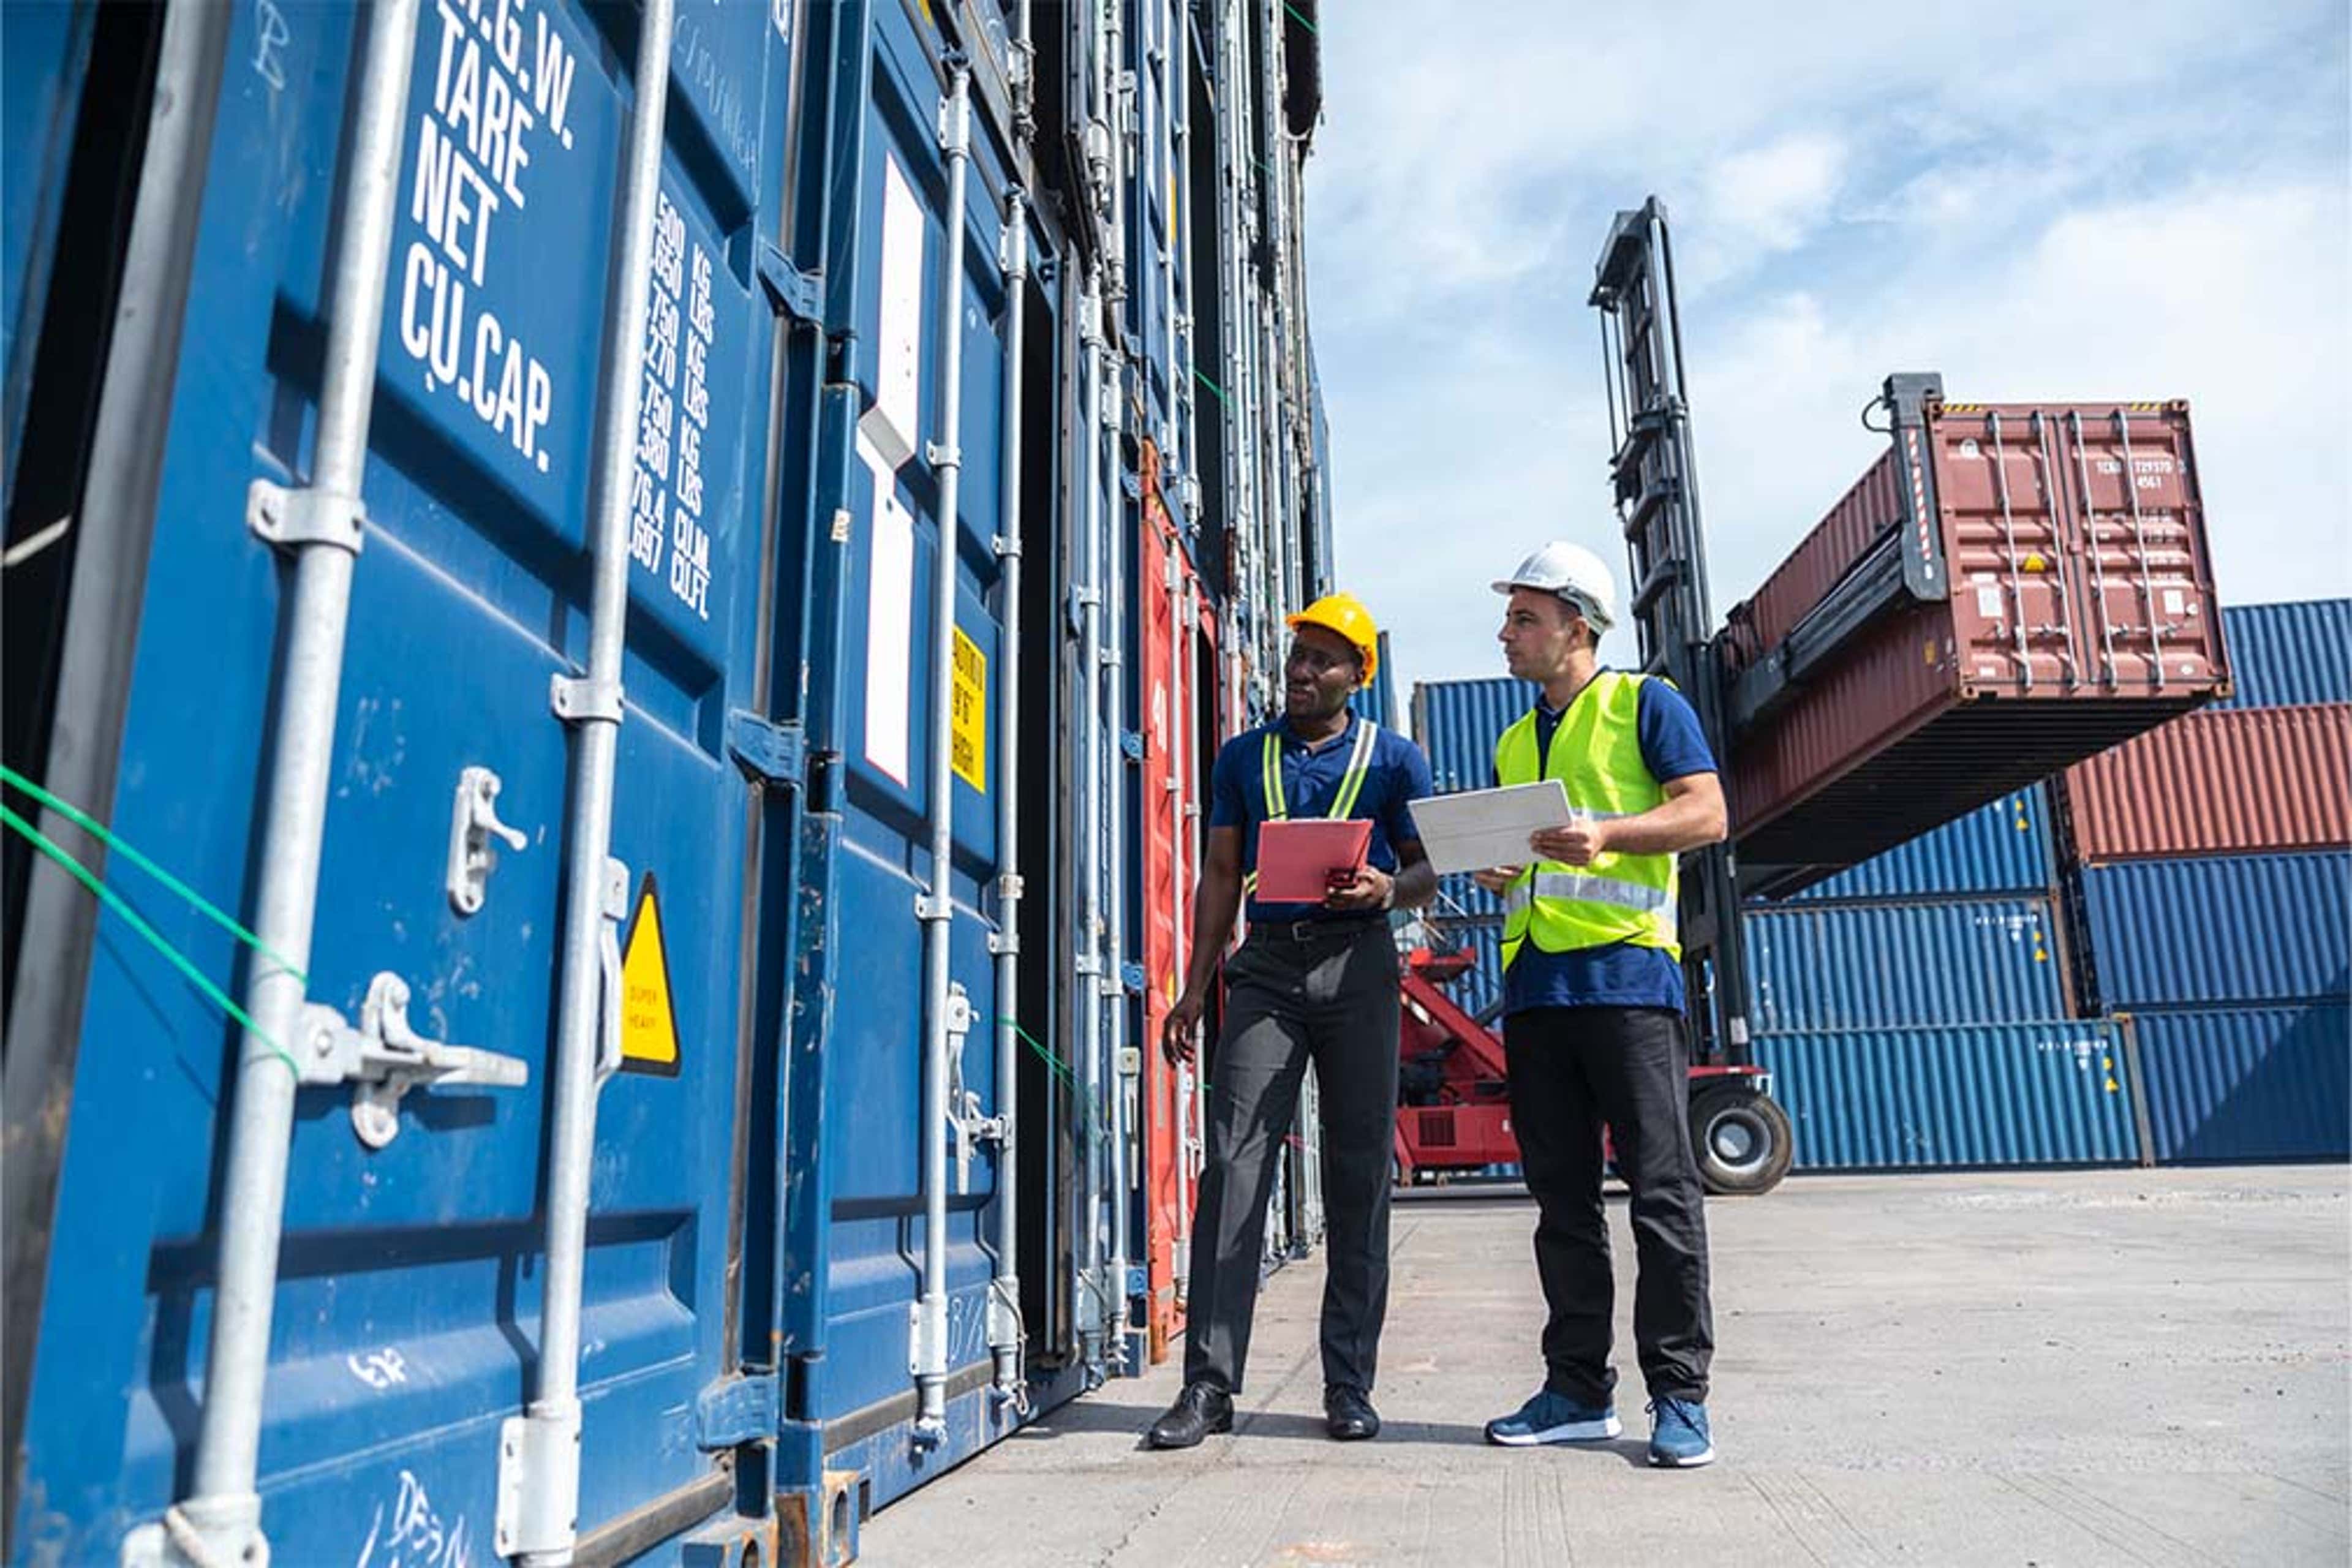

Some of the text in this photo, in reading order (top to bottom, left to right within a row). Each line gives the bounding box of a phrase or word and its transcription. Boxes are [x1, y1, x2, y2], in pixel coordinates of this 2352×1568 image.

[434, 0, 534, 209] TARE
[456, 0, 575, 150] .G.W.
[412, 113, 500, 287] NET
[692, 243, 712, 304] KG
[690, 281, 714, 345] LBS
[401, 242, 551, 473] CU.CAP.
[686, 327, 706, 383] KG
[683, 367, 709, 430] LBS
[679, 414, 701, 470] KG
[676, 458, 703, 517] LBS
